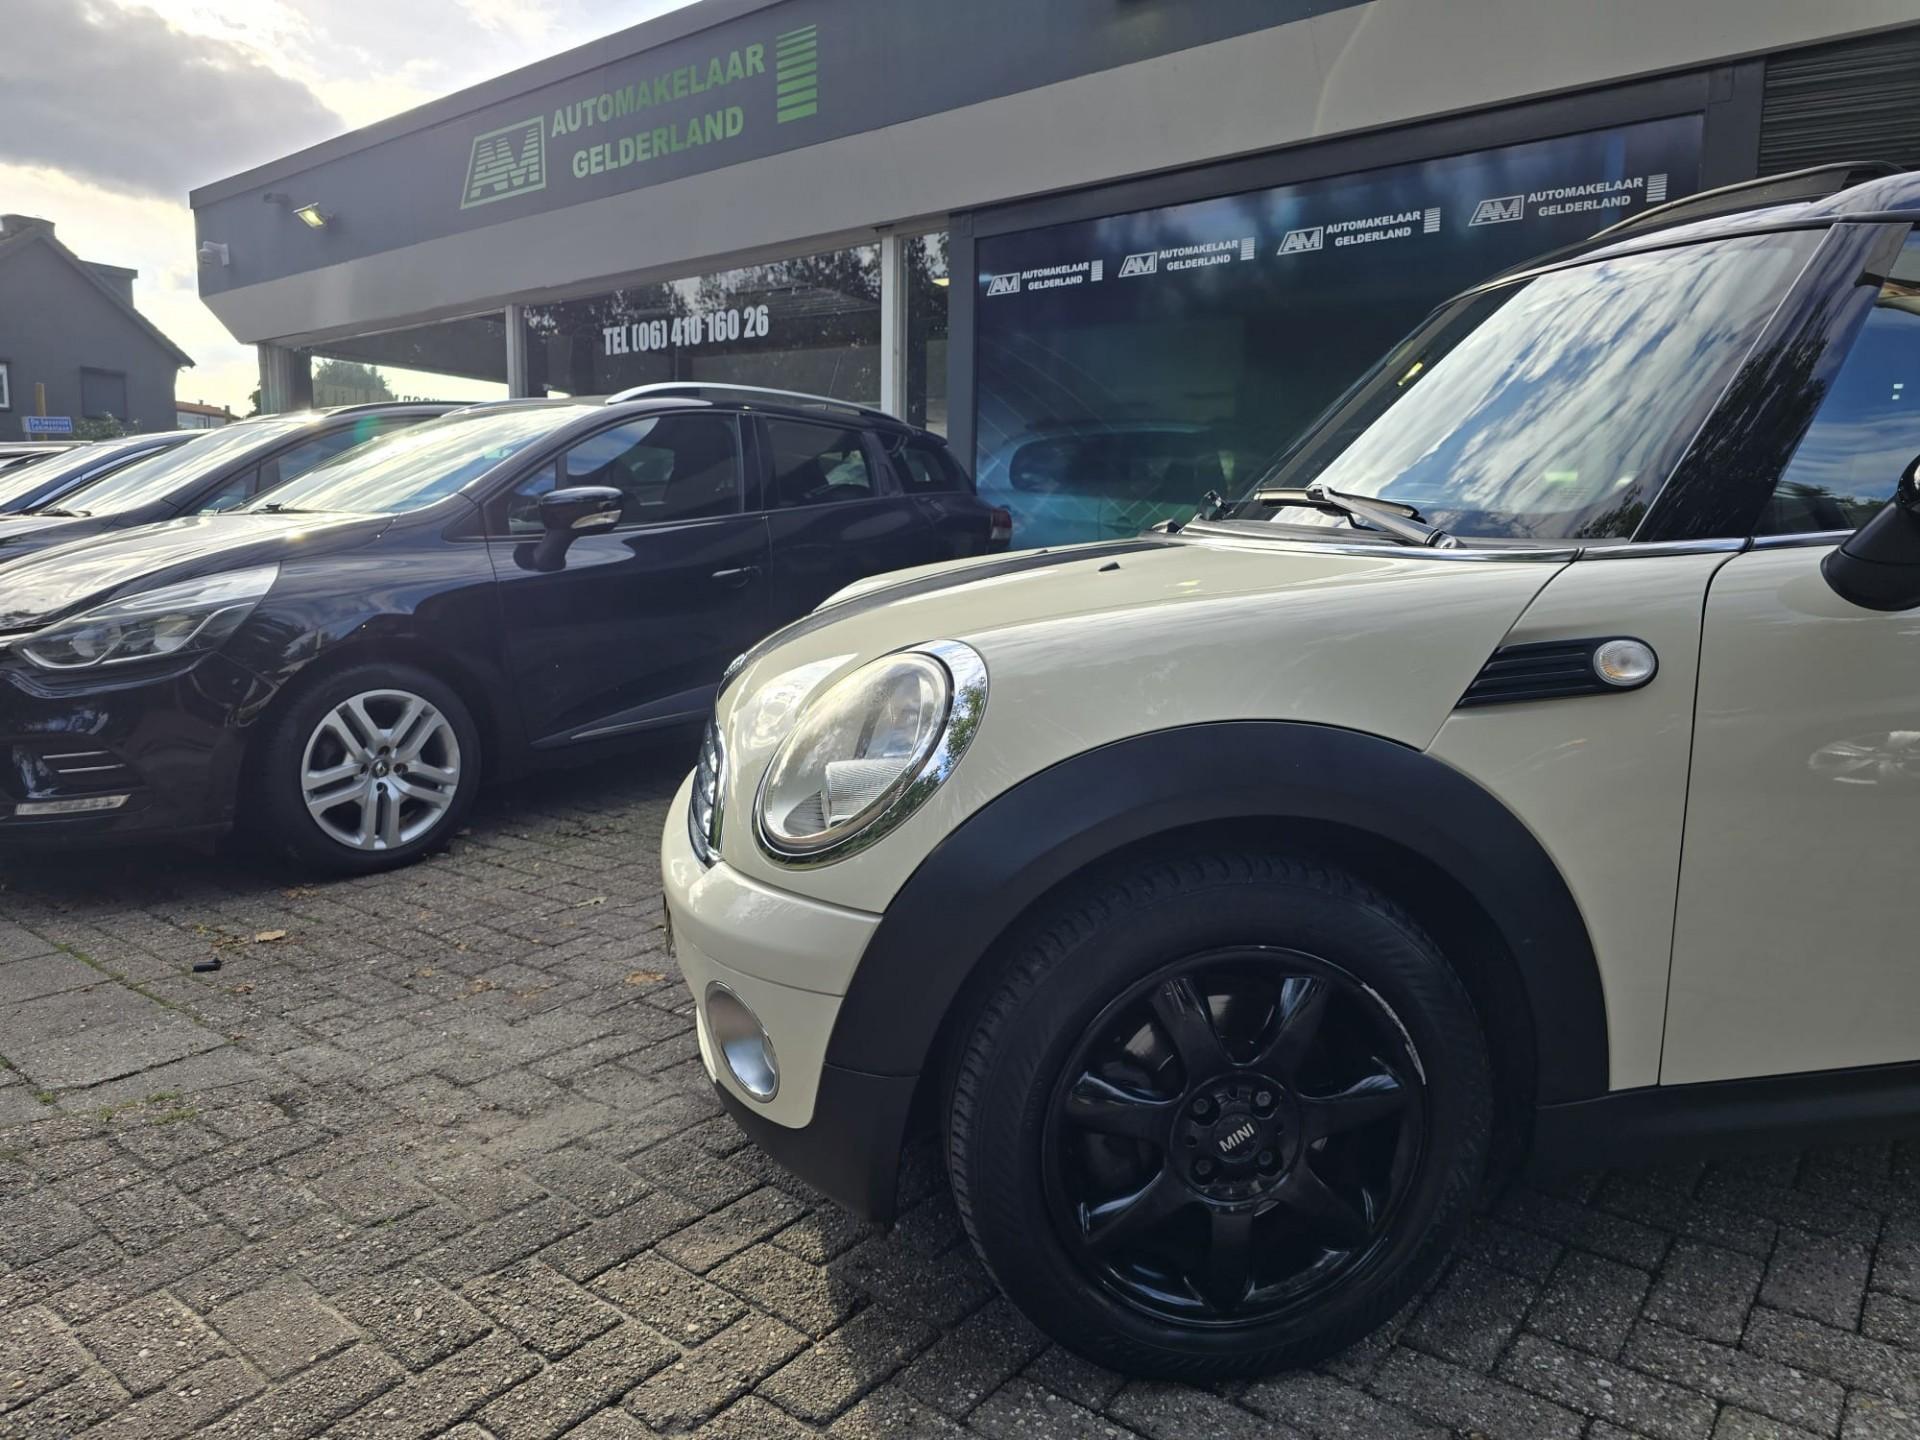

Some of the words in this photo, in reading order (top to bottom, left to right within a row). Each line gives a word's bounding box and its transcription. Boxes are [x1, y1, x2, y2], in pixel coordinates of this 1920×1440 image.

[551, 43, 766, 138] AUTOMAKELAAR
[573, 106, 744, 179] GELDERLAND
[1527, 176, 1644, 203] AUTOMAKELAAR
[1538, 195, 1631, 217] GELDERLAND
[1325, 210, 1421, 234] AUTOMAKELAAR
[1334, 227, 1412, 247] GELDERLAND
[1159, 239, 1239, 260] AUTOMAKELAAR
[1021, 262, 1089, 280] AUTOMAKELAAR
[1166, 254, 1231, 271] GELDERLAND
[1028, 275, 1083, 291] GELDERLAND
[603, 326, 630, 356] TEL
[632, 320, 668, 353] (06)
[671, 315, 700, 347] 410
[705, 308, 740, 343] 160
[743, 304, 769, 338] 26
[1218, 1122, 1255, 1152] MINI
